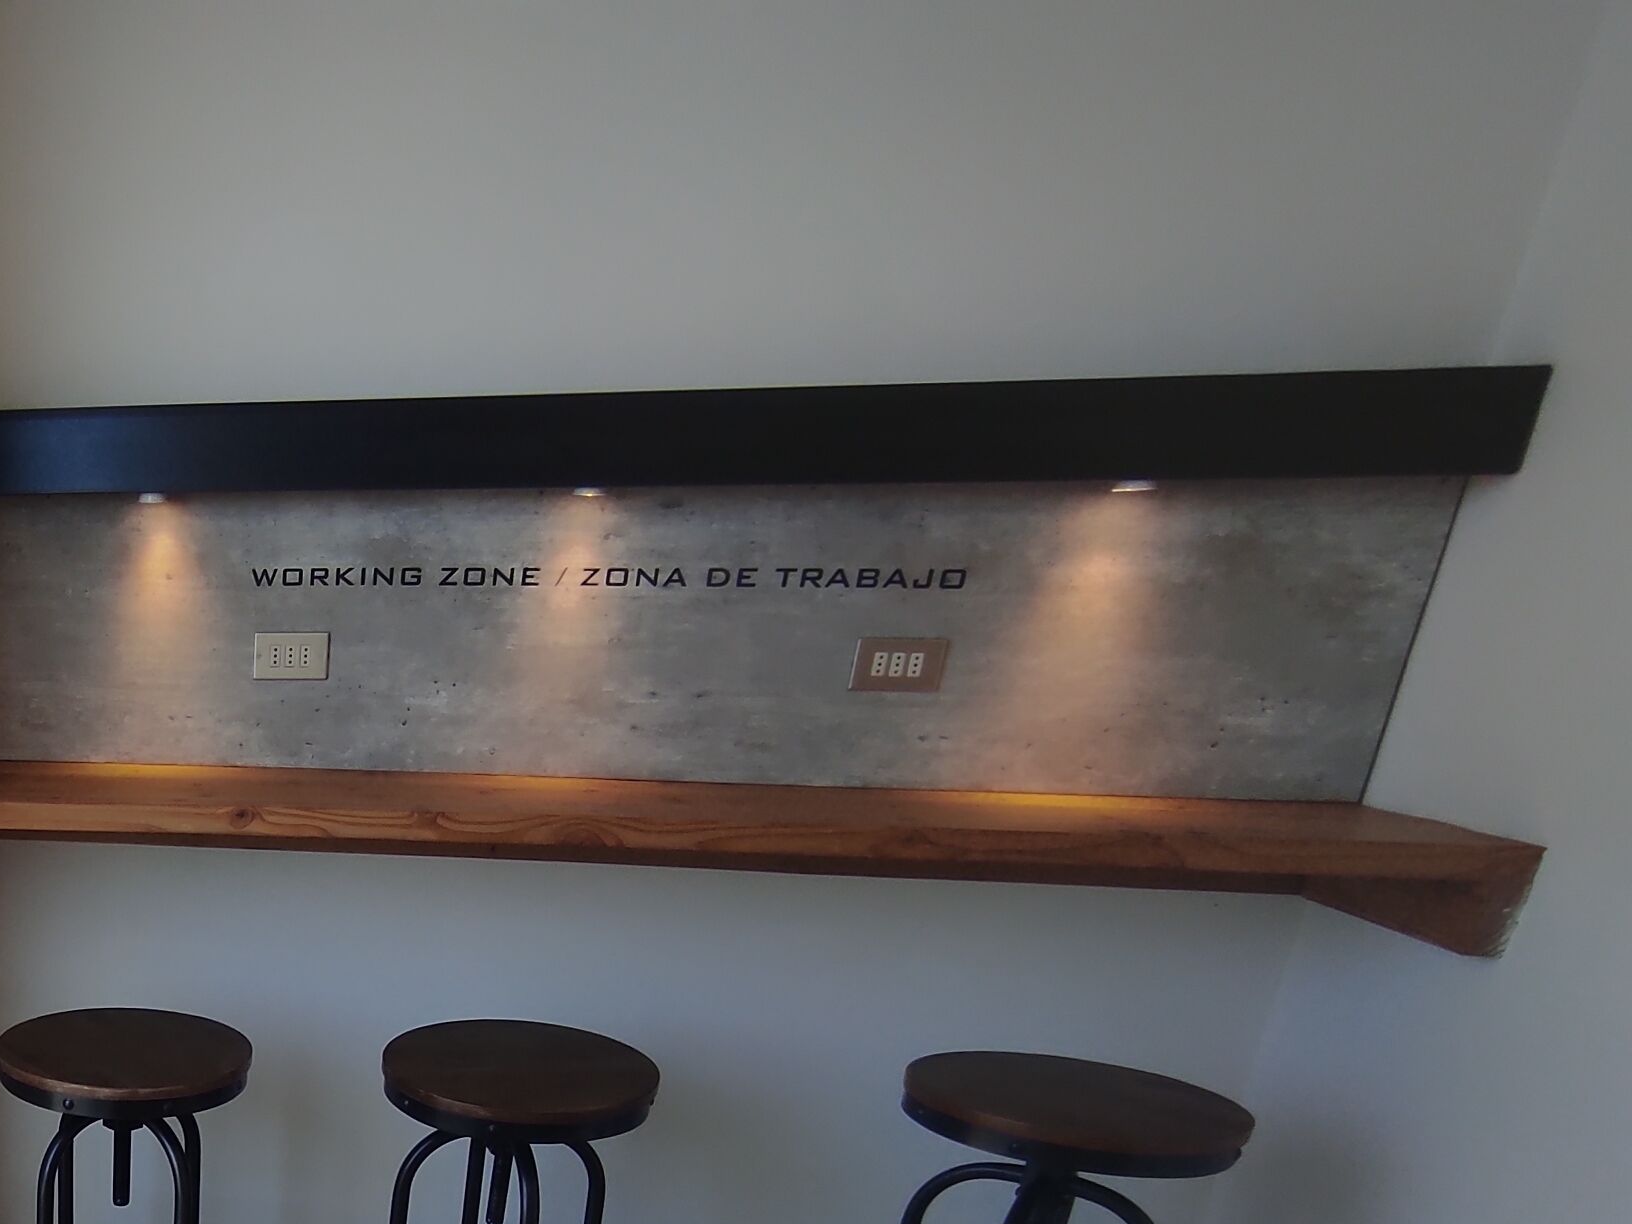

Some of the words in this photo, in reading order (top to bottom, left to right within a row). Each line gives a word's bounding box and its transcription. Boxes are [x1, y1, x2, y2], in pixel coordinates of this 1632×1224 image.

[252, 567, 423, 587] WORKING
[438, 567, 541, 587] ZONE
[554, 567, 569, 587] /
[580, 568, 688, 587] ZONA
[705, 567, 759, 588] DE
[775, 567, 968, 590] TRABAJO
